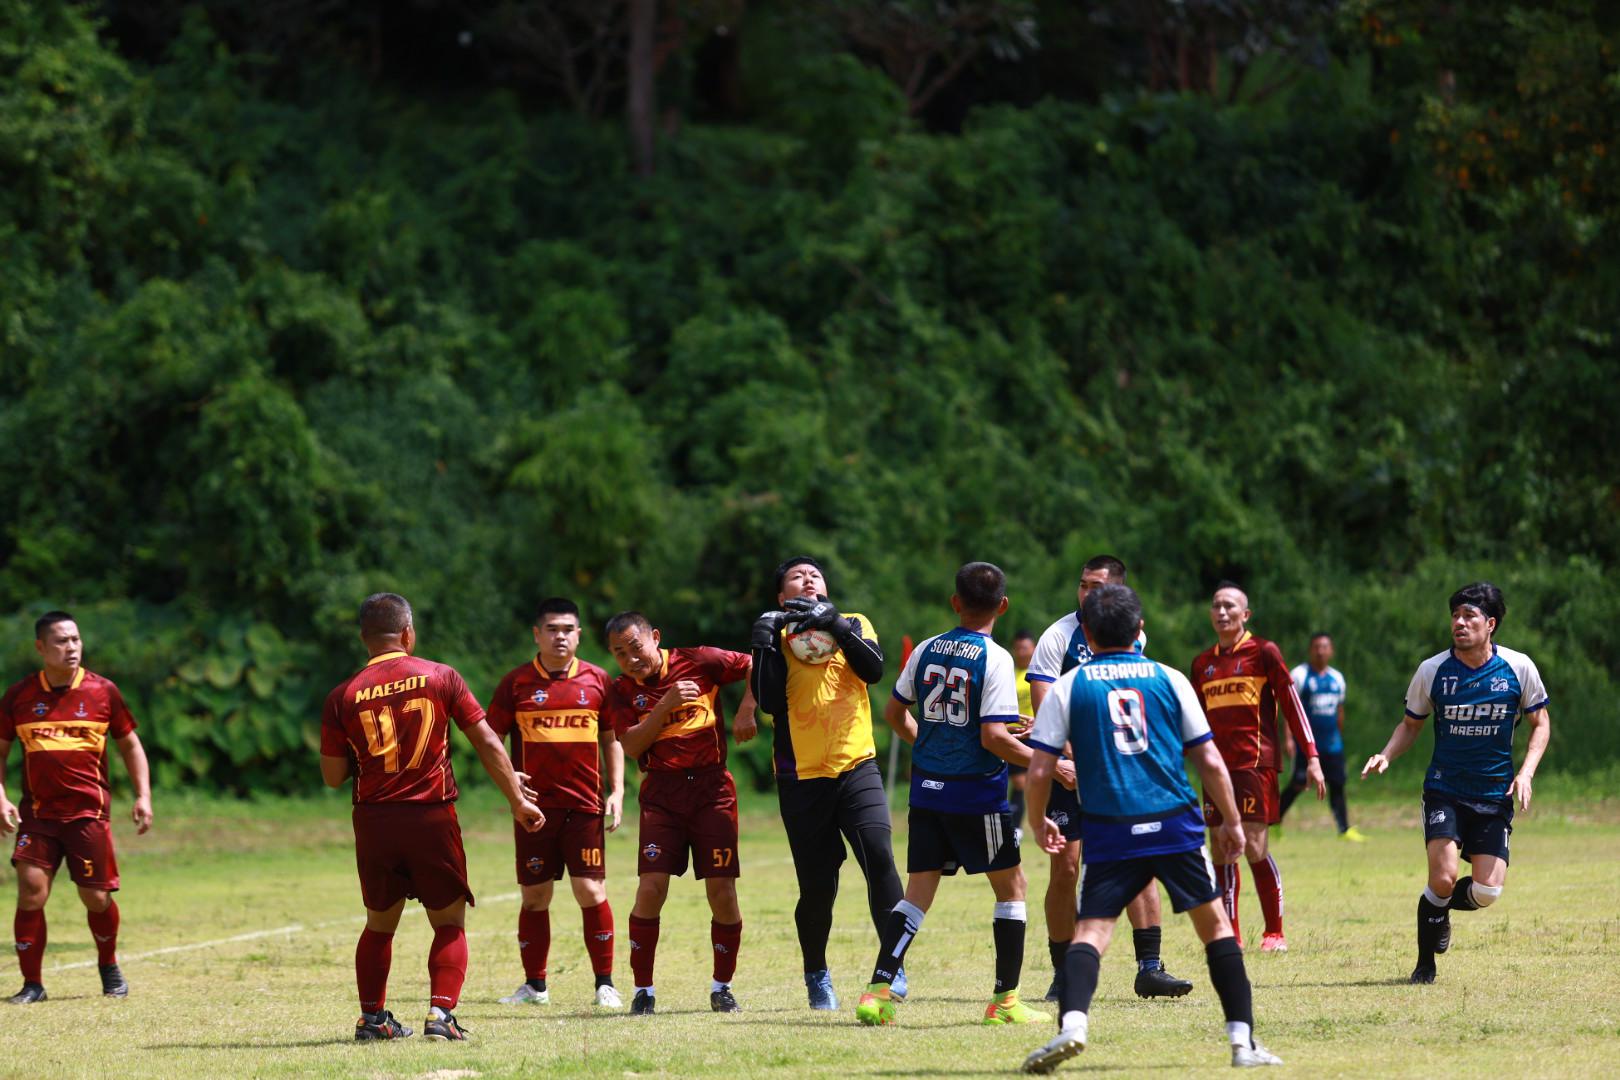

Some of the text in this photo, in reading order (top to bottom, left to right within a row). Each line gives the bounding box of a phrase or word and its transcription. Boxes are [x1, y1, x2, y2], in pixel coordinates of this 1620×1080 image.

[930, 639, 983, 661] SURACHAI
[1082, 662, 1157, 681] TEERAYUT
[355, 674, 430, 704] MAESOT
[922, 663, 971, 727] 23
[1203, 681, 1246, 699] POLICE
[1441, 675, 1459, 696] 17
[532, 715, 590, 729] POLICE
[1107, 687, 1149, 756] 9
[1449, 724, 1501, 736] MAESOT
[31, 726, 92, 740] POLICE
[359, 697, 436, 774] 47
[1243, 797, 1256, 814] 12
[580, 848, 601, 867] 40
[712, 848, 732, 867] 57
[83, 859, 93, 877] 5
